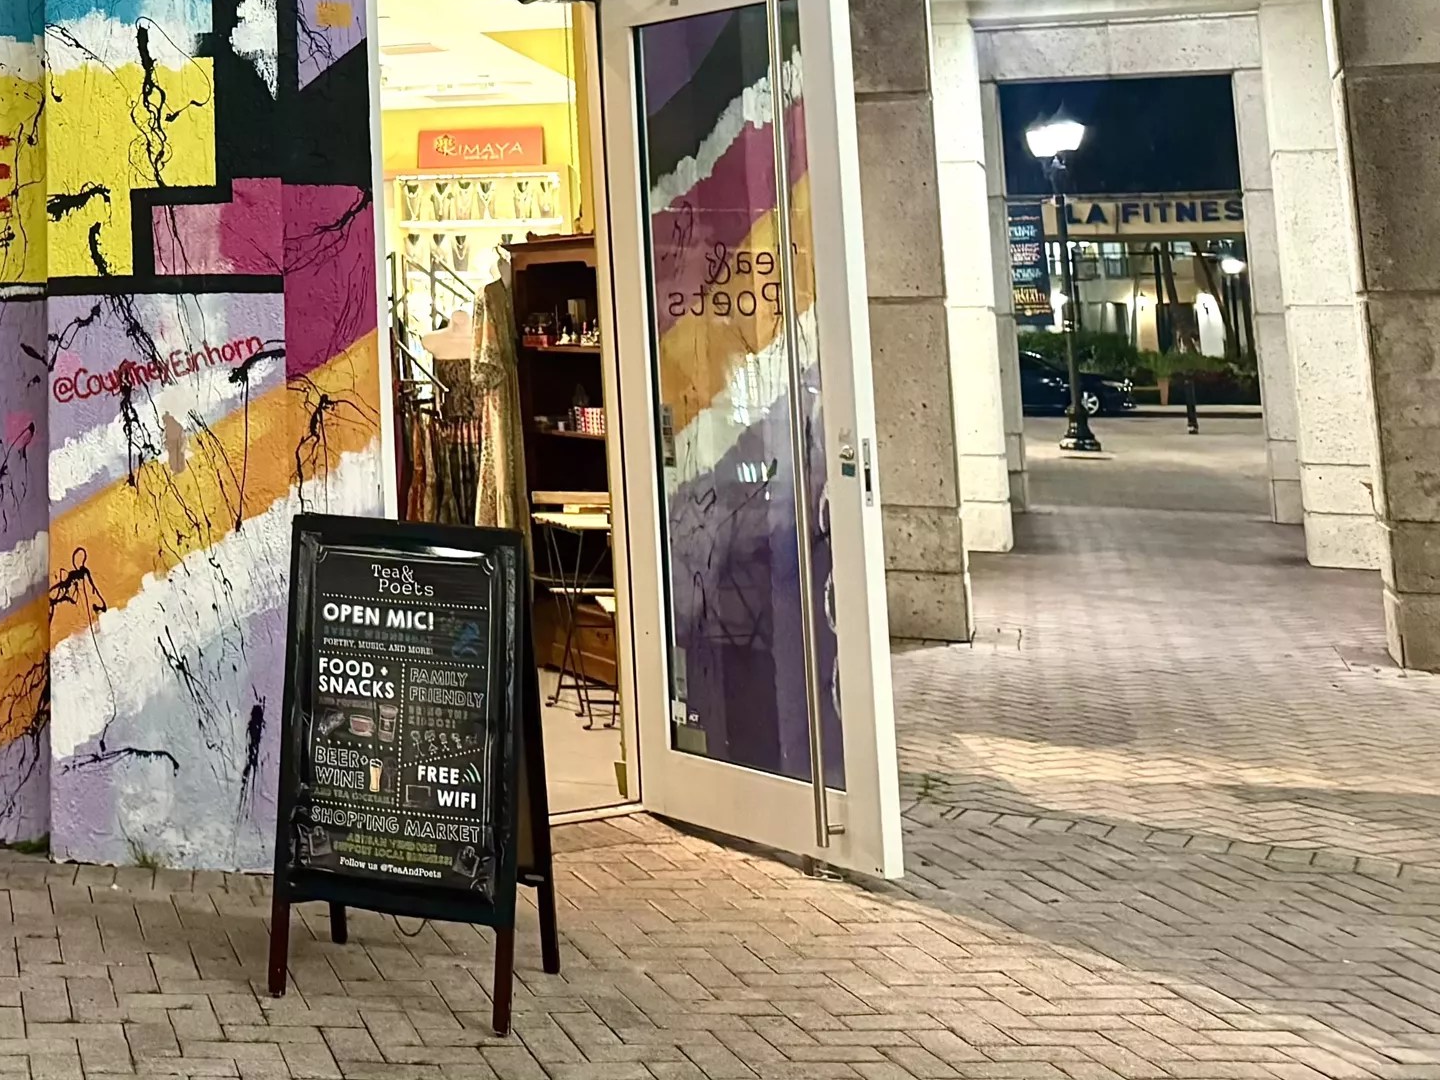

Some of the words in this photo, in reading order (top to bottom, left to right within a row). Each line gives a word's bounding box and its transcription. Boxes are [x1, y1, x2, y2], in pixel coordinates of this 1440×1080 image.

[1066, 203, 1109, 224] LA
[371, 563, 415, 584] Tea&
[378, 578, 435, 597] Poets
[323, 602, 380, 626] OPEN
[386, 609, 435, 631] MIC!
[323, 637, 357, 649] POETRY,
[358, 640, 387, 651] MUSIC,
[388, 643, 406, 653] AND
[408, 645, 434, 656] MORE!
[318, 657, 375, 678] FOOD
[409, 668, 469, 687] FAMILY
[318, 675, 396, 699] SNACKS
[409, 686, 485, 708] FRIENDLY
[315, 766, 365, 789] WINE
[417, 765, 459, 785] FREE
[437, 789, 477, 810] WIFI
[311, 805, 400, 834] SHOPPING
[404, 819, 480, 844] MARKET
[374, 847, 405, 861] LOCAL
[339, 856, 366, 869] Follow
[368, 861, 378, 871] us
[380, 862, 442, 880] @TeaAndPoets
